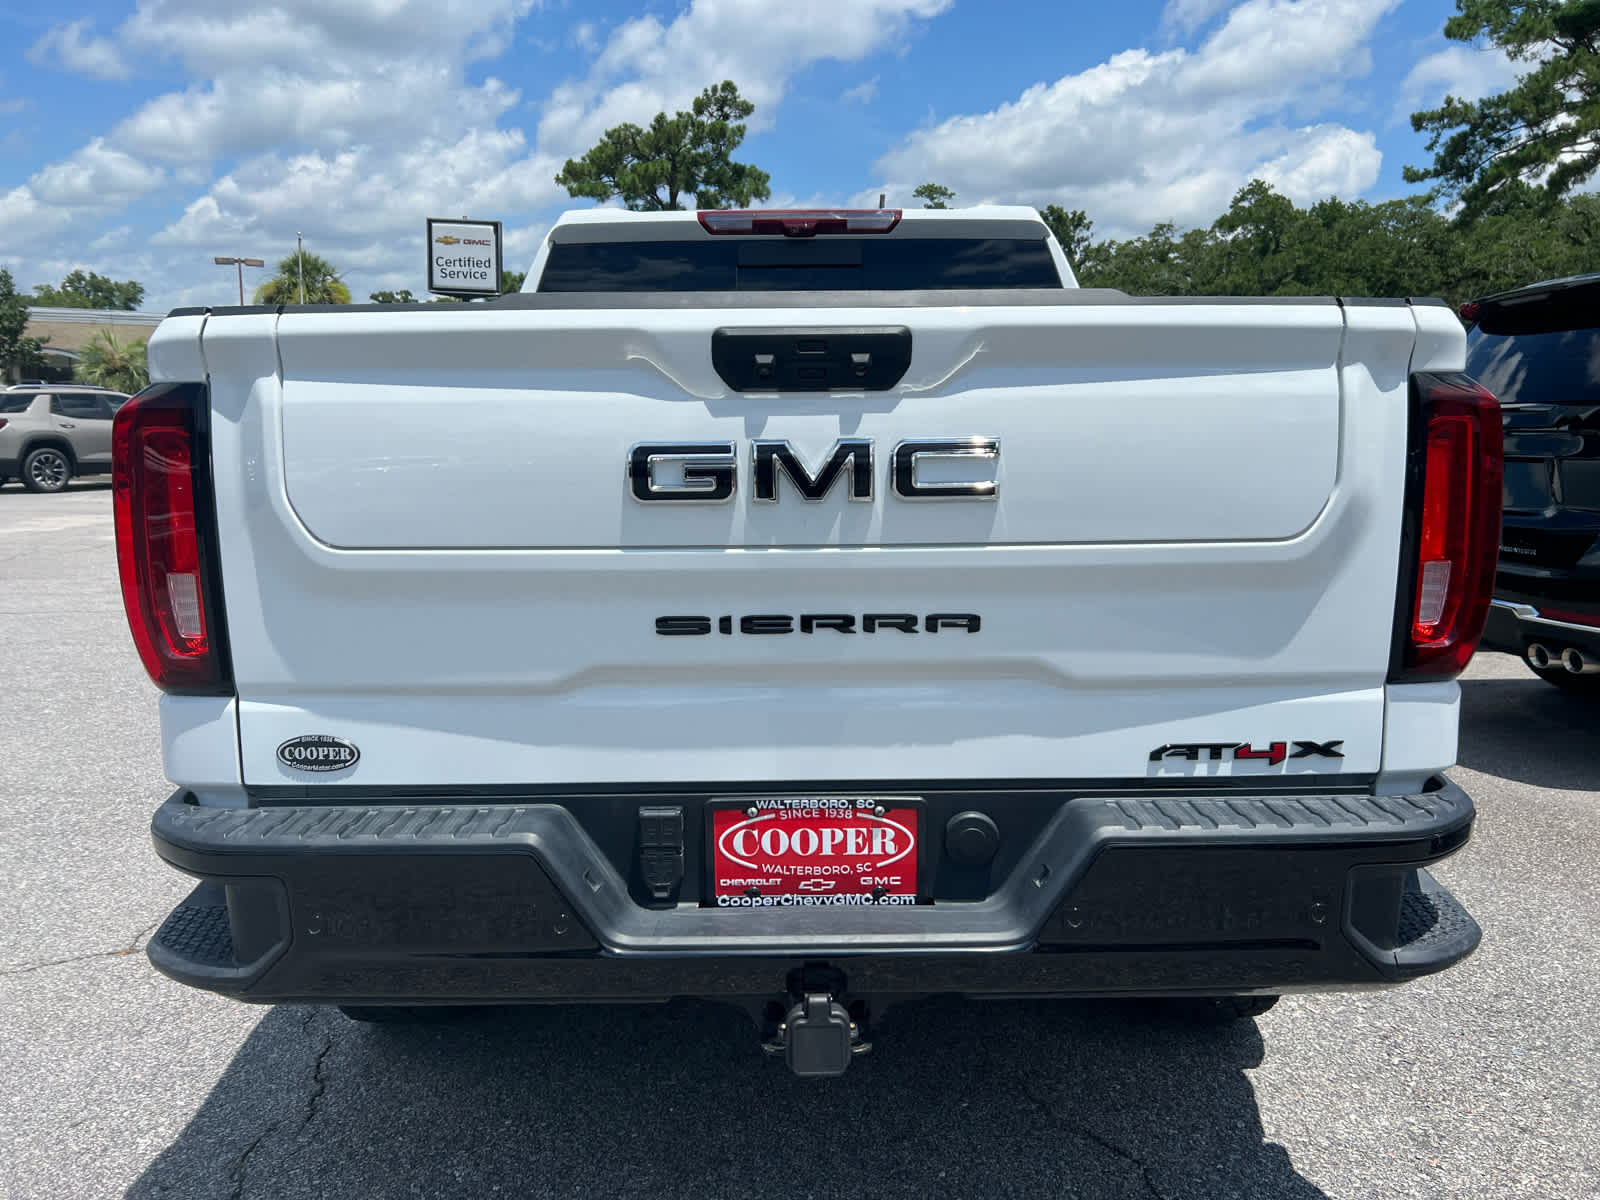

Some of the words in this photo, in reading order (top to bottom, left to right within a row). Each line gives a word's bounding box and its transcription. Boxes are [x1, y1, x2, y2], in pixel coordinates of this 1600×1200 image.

[435, 256, 491, 268] Certified
[440, 268, 487, 280] Service
[627, 437, 1001, 503] GMC
[655, 613, 981, 635] SIERRA
[284, 746, 351, 760] COOPER
[1149, 740, 1345, 766] AT4X
[856, 800, 875, 809] SC
[779, 808, 820, 820] SINCE
[825, 808, 853, 819] 1938
[732, 827, 898, 856] COOPER
[761, 863, 853, 875] WALTERBORO,
[856, 862, 872, 873] SC
[720, 878, 782, 887] CHEVROLET
[860, 876, 901, 885] GMC
